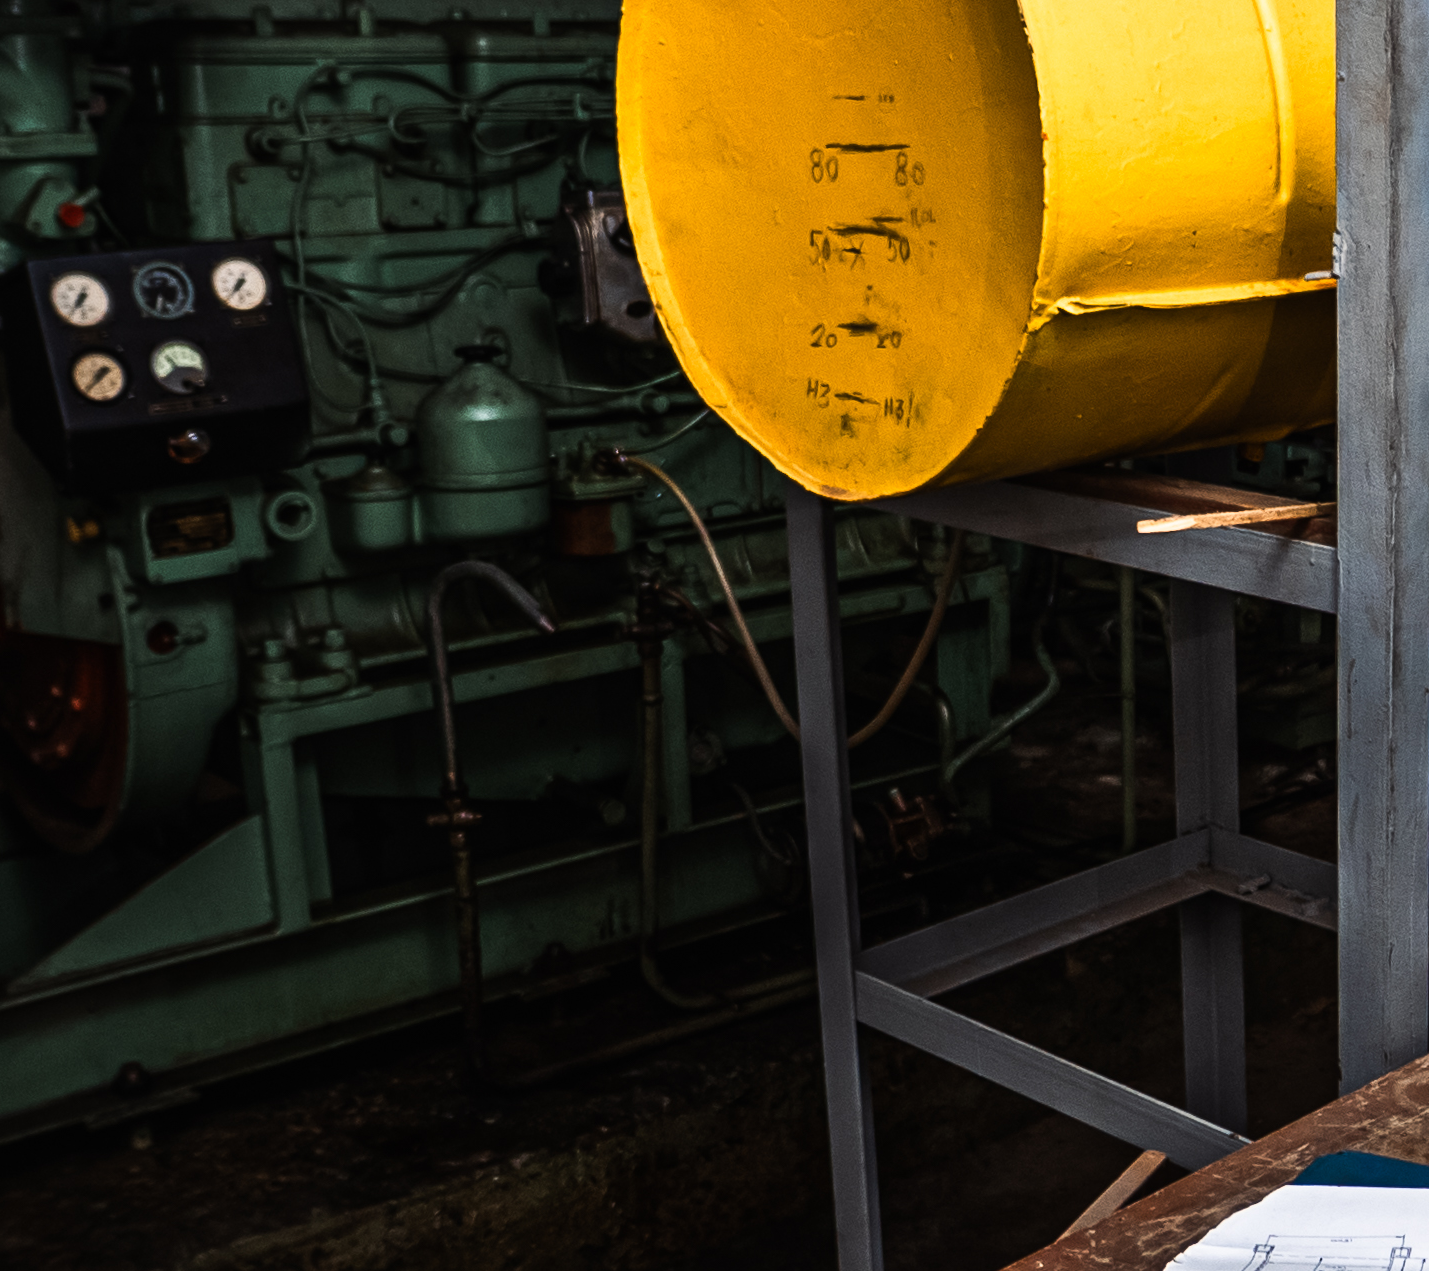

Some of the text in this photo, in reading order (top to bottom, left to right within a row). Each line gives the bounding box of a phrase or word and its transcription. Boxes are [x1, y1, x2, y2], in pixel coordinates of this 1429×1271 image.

[810, 148, 839, 183] 80
[895, 151, 925, 187] 80
[810, 323, 838, 348] 20
